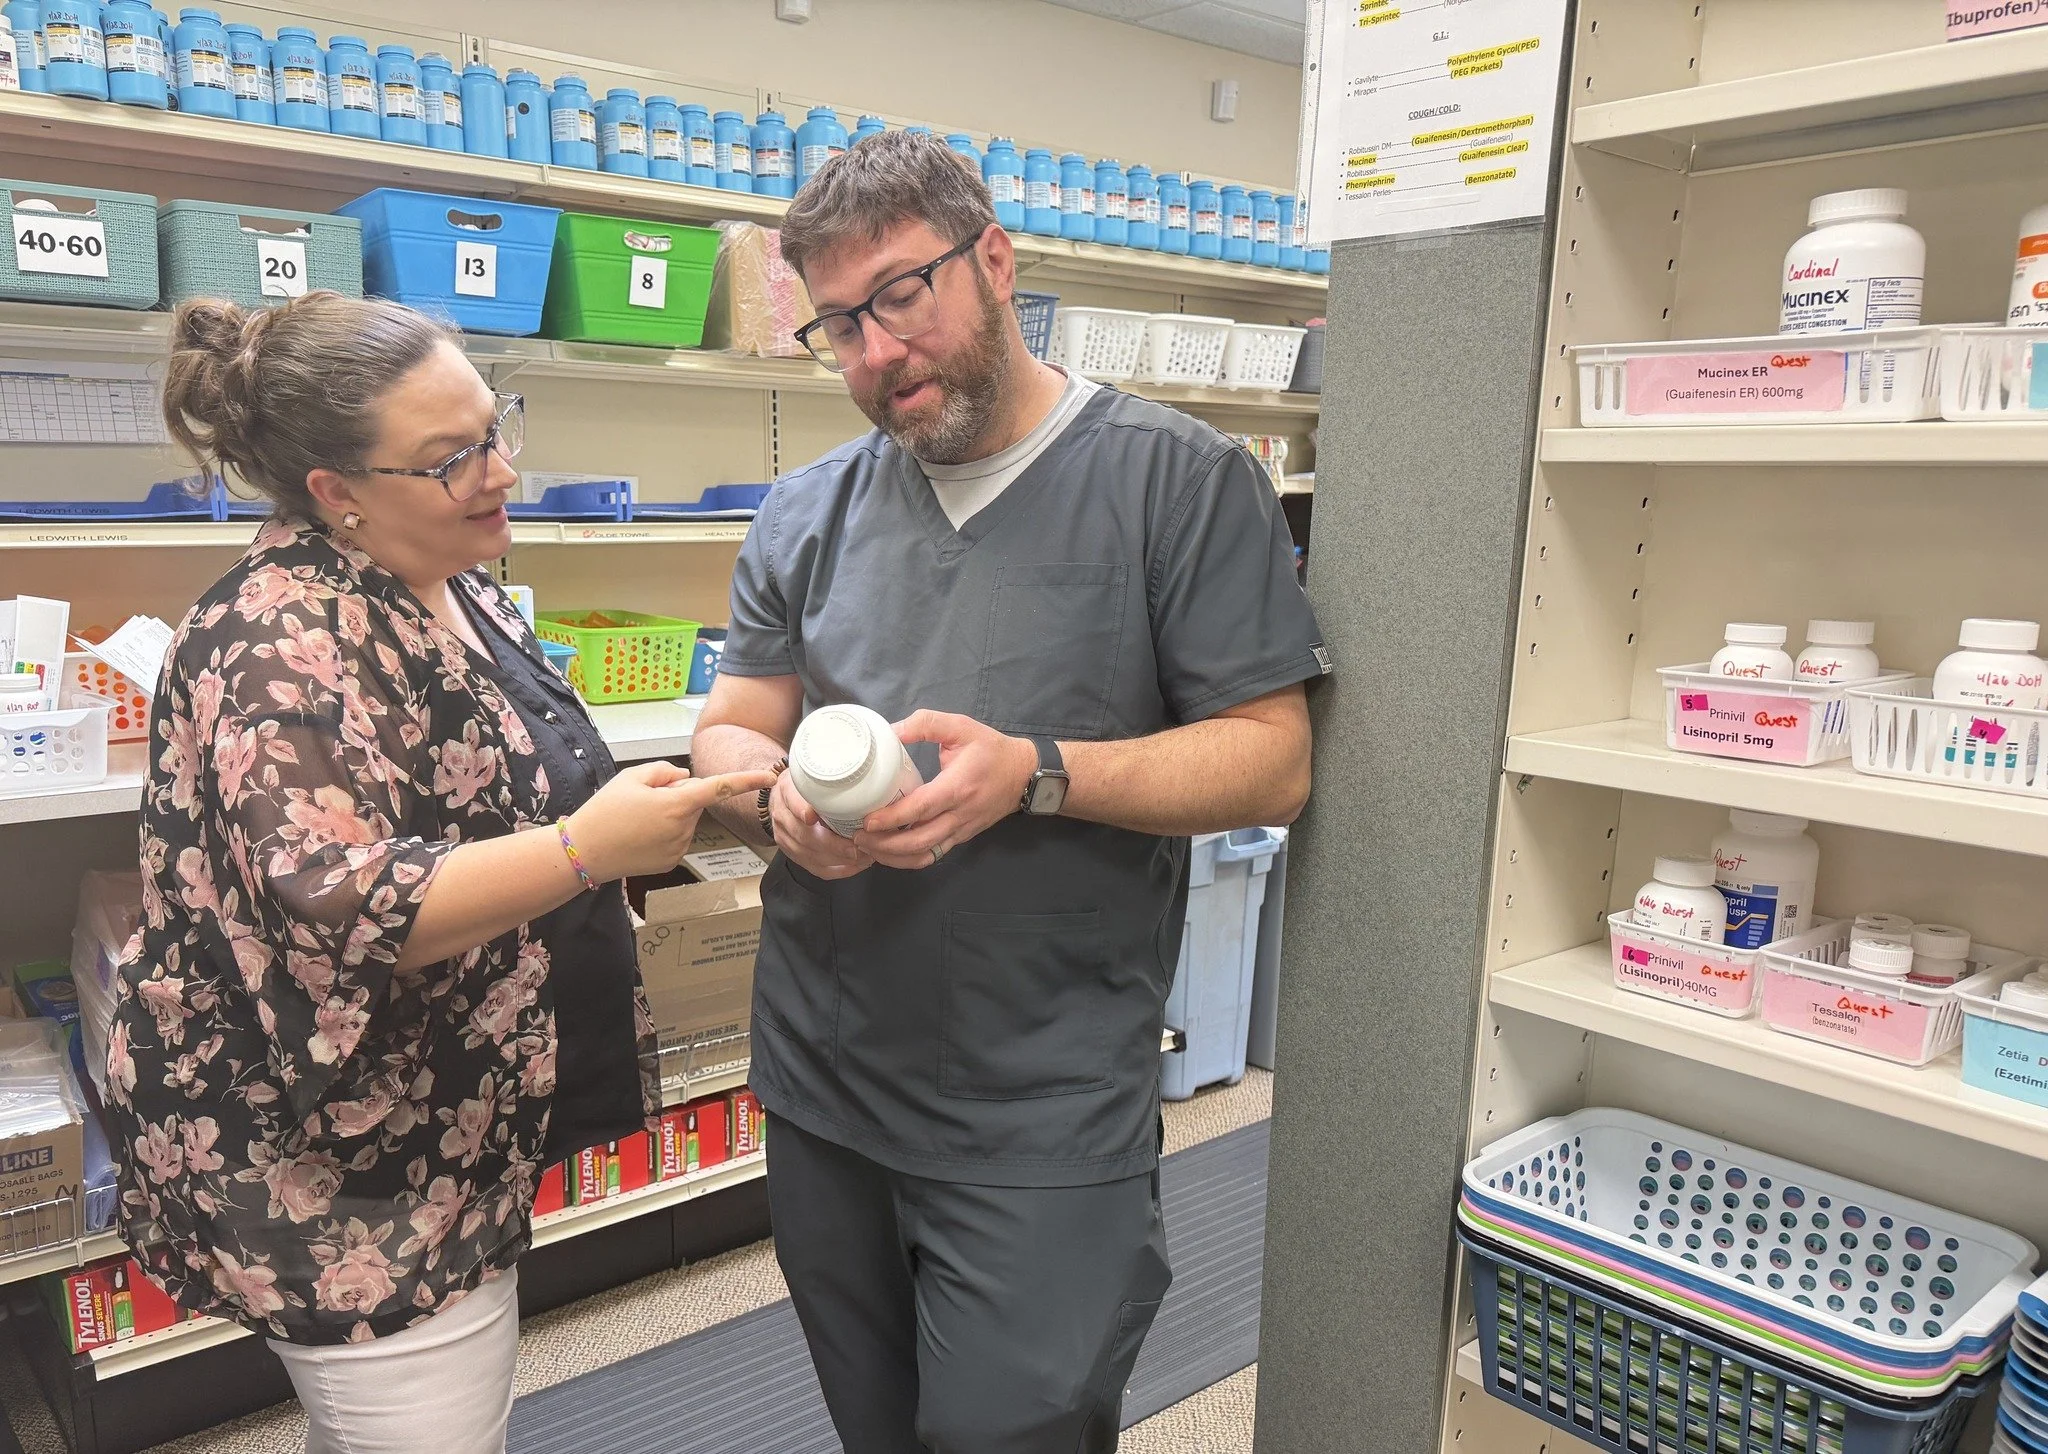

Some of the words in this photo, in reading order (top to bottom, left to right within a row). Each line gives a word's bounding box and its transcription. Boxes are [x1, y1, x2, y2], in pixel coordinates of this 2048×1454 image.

[1359, 11, 1400, 28] Tri-Sprintec
[1432, 31, 1449, 42] G.I.:
[1447, 51, 1495, 67] Polyethylene
[1497, 38, 1540, 57] Gycol(PEG)
[1450, 67, 1469, 80] (PEG
[1471, 60, 1503, 75] Packets)
[1354, 74, 1379, 86] Gavilyte
[1353, 86, 1378, 98] Mirapex
[1408, 103, 1461, 120] COUGH/COLD:
[1411, 116, 1534, 147] (Guaifenesin/Dextromethorphan)
[1470, 132, 1513, 149] (Guaifenesin)
[1348, 144, 1380, 156] Robitussin
[1381, 141, 1392, 150] DM
[1458, 148, 1505, 163] (Guaifenesin
[1506, 142, 1529, 154] Clear)
[1347, 156, 1376, 167] Mucinex
[1346, 167, 1378, 179] Robitussin
[1464, 168, 1517, 186] (Benzonatate)
[1345, 177, 1395, 190] Phenylephrine
[1344, 192, 1372, 201] Tessalon
[1372, 189, 1392, 198] Perles
[265, 258, 297, 280] 20
[464, 258, 486, 277] 13
[1788, 258, 1839, 282] Cardinal
[642, 273, 654, 290] 8
[1808, 318, 1847, 329] CONGESTION
[1770, 354, 1811, 370] Quest
[1698, 367, 1749, 380] Mucinex
[1752, 366, 1769, 379] ER
[1665, 388, 1736, 403] (Guaifenesin
[1740, 387, 1760, 402] ER)
[1763, 386, 1804, 401] 600mg
[90, 534, 129, 542] LEWIS
[1723, 660, 1772, 678] Quest
[1800, 659, 1843, 677] Quest
[1710, 708, 1745, 723] Prinivil
[1754, 711, 1799, 729] Quest
[1683, 725, 1739, 743] Lisinopril
[1743, 734, 1774, 749] 5mg
[1713, 848, 1748, 872] Quest
[1662, 901, 1696, 920] Quest
[1729, 908, 1747, 917] USP
[1648, 952, 1684, 971] Prinivil
[1701, 964, 1748, 982] Quest
[1811, 1003, 1861, 1025] Tessalon
[1837, 996, 1894, 1019] Quest
[1812, 1016, 1857, 1036] (benzonatate)
[1997, 1046, 2029, 1062] Zetia
[736, 1098, 749, 1154] TYLENOL
[662, 1118, 677, 1177] TYLENOL
[38, 1169, 64, 1181] BAGS
[580, 1147, 595, 1200] TYLENO
[75, 1277, 99, 1349] TYLENOL
[93, 1293, 104, 1321] SEVERE
[96, 1320, 106, 1342] SINUS
